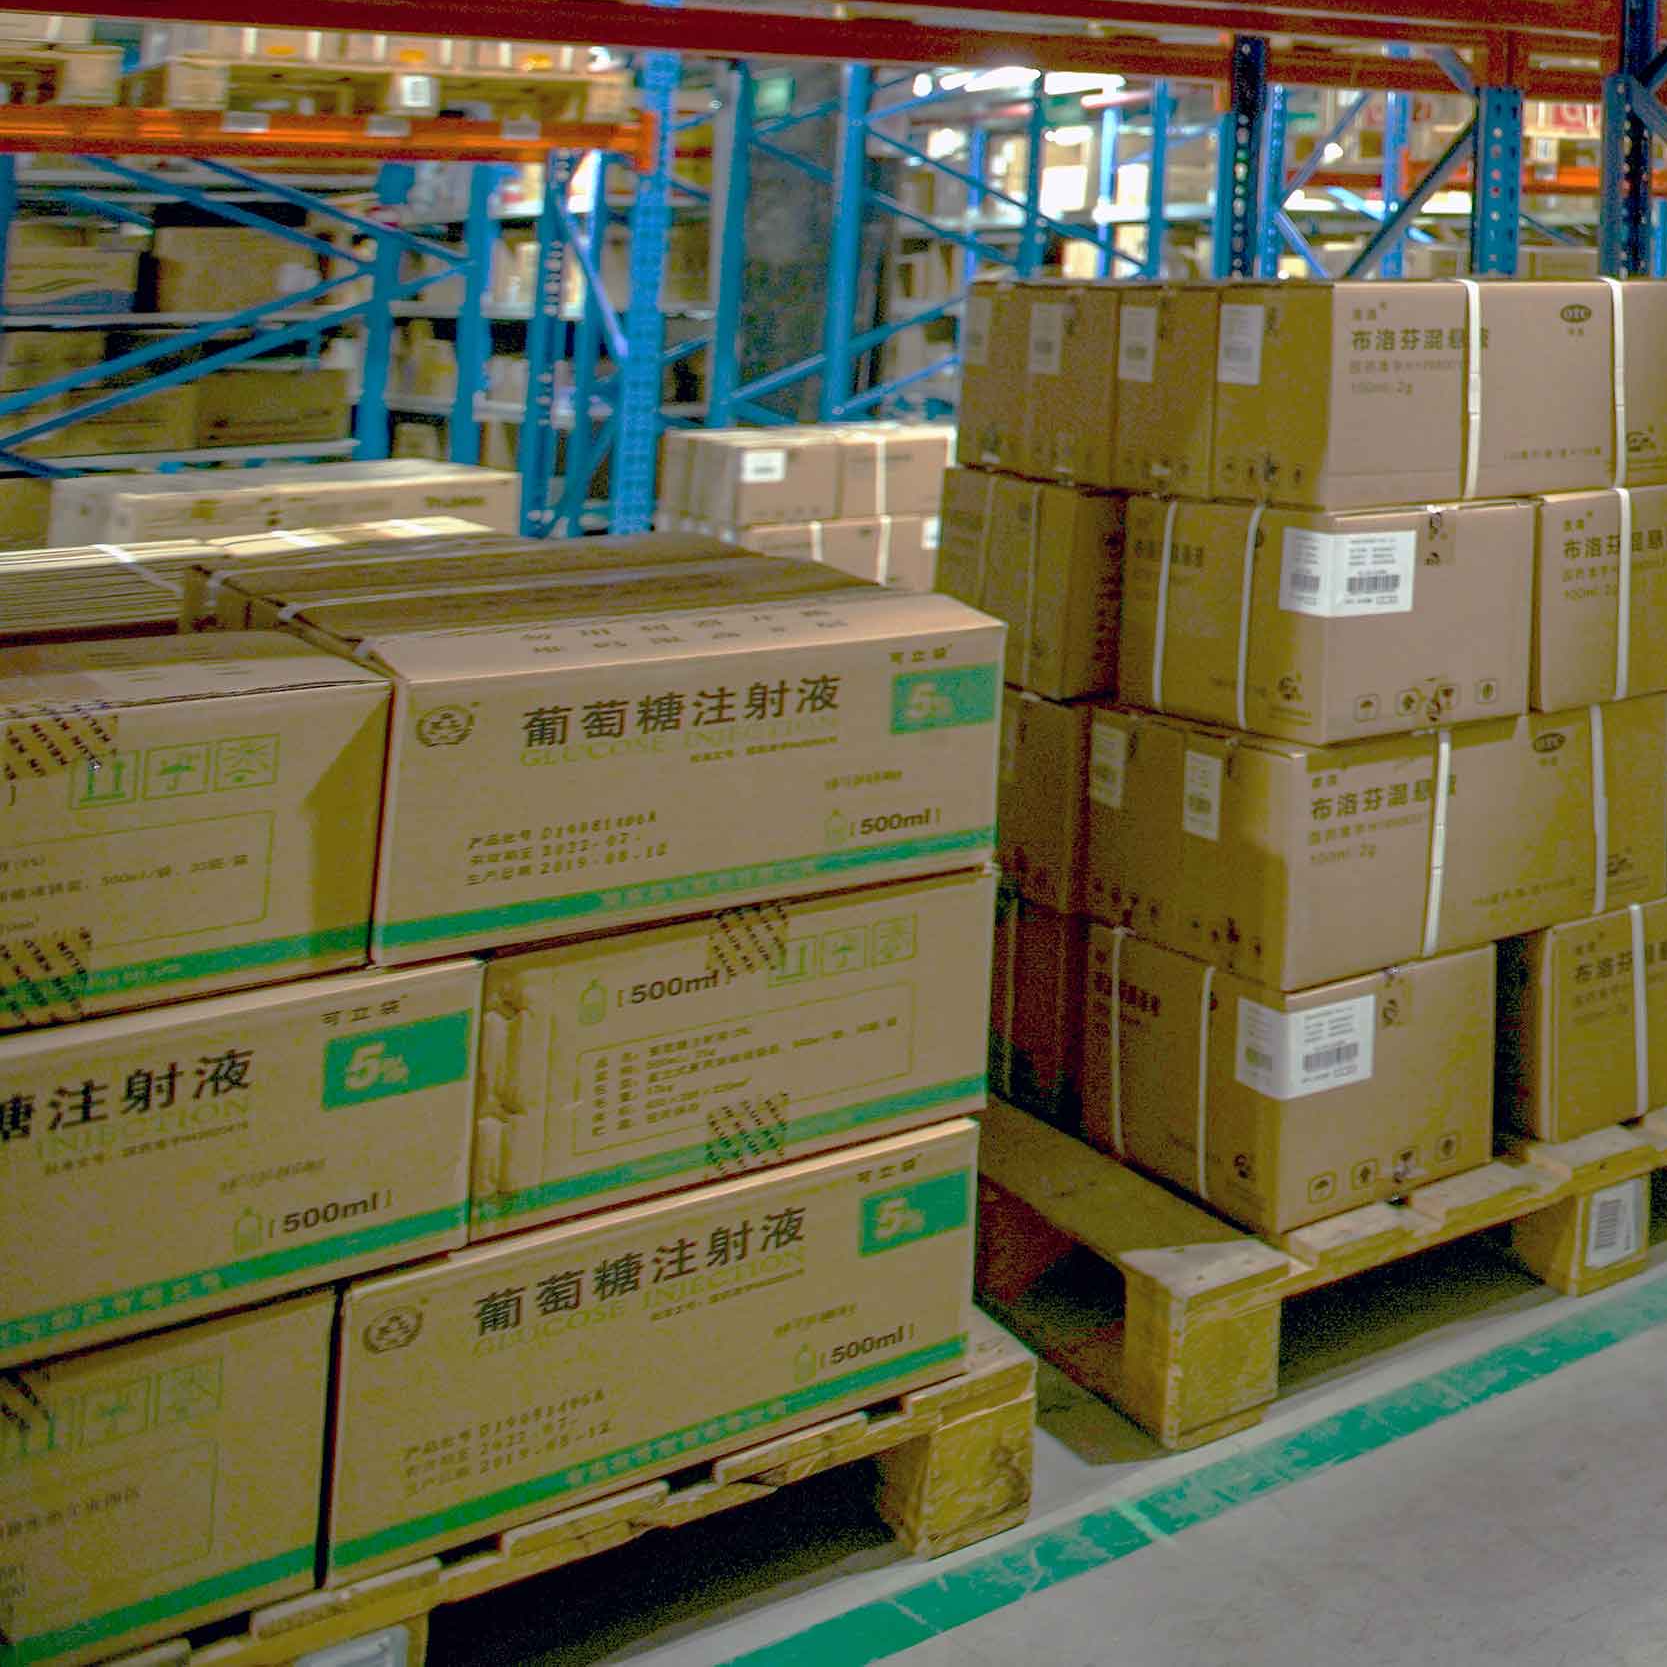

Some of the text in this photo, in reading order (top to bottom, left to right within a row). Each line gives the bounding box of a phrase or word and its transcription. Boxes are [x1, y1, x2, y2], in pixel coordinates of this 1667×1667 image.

[522, 674, 842, 749] 葡萄糖注射液
[474, 1205, 807, 1336] 葡萄糖注射液
